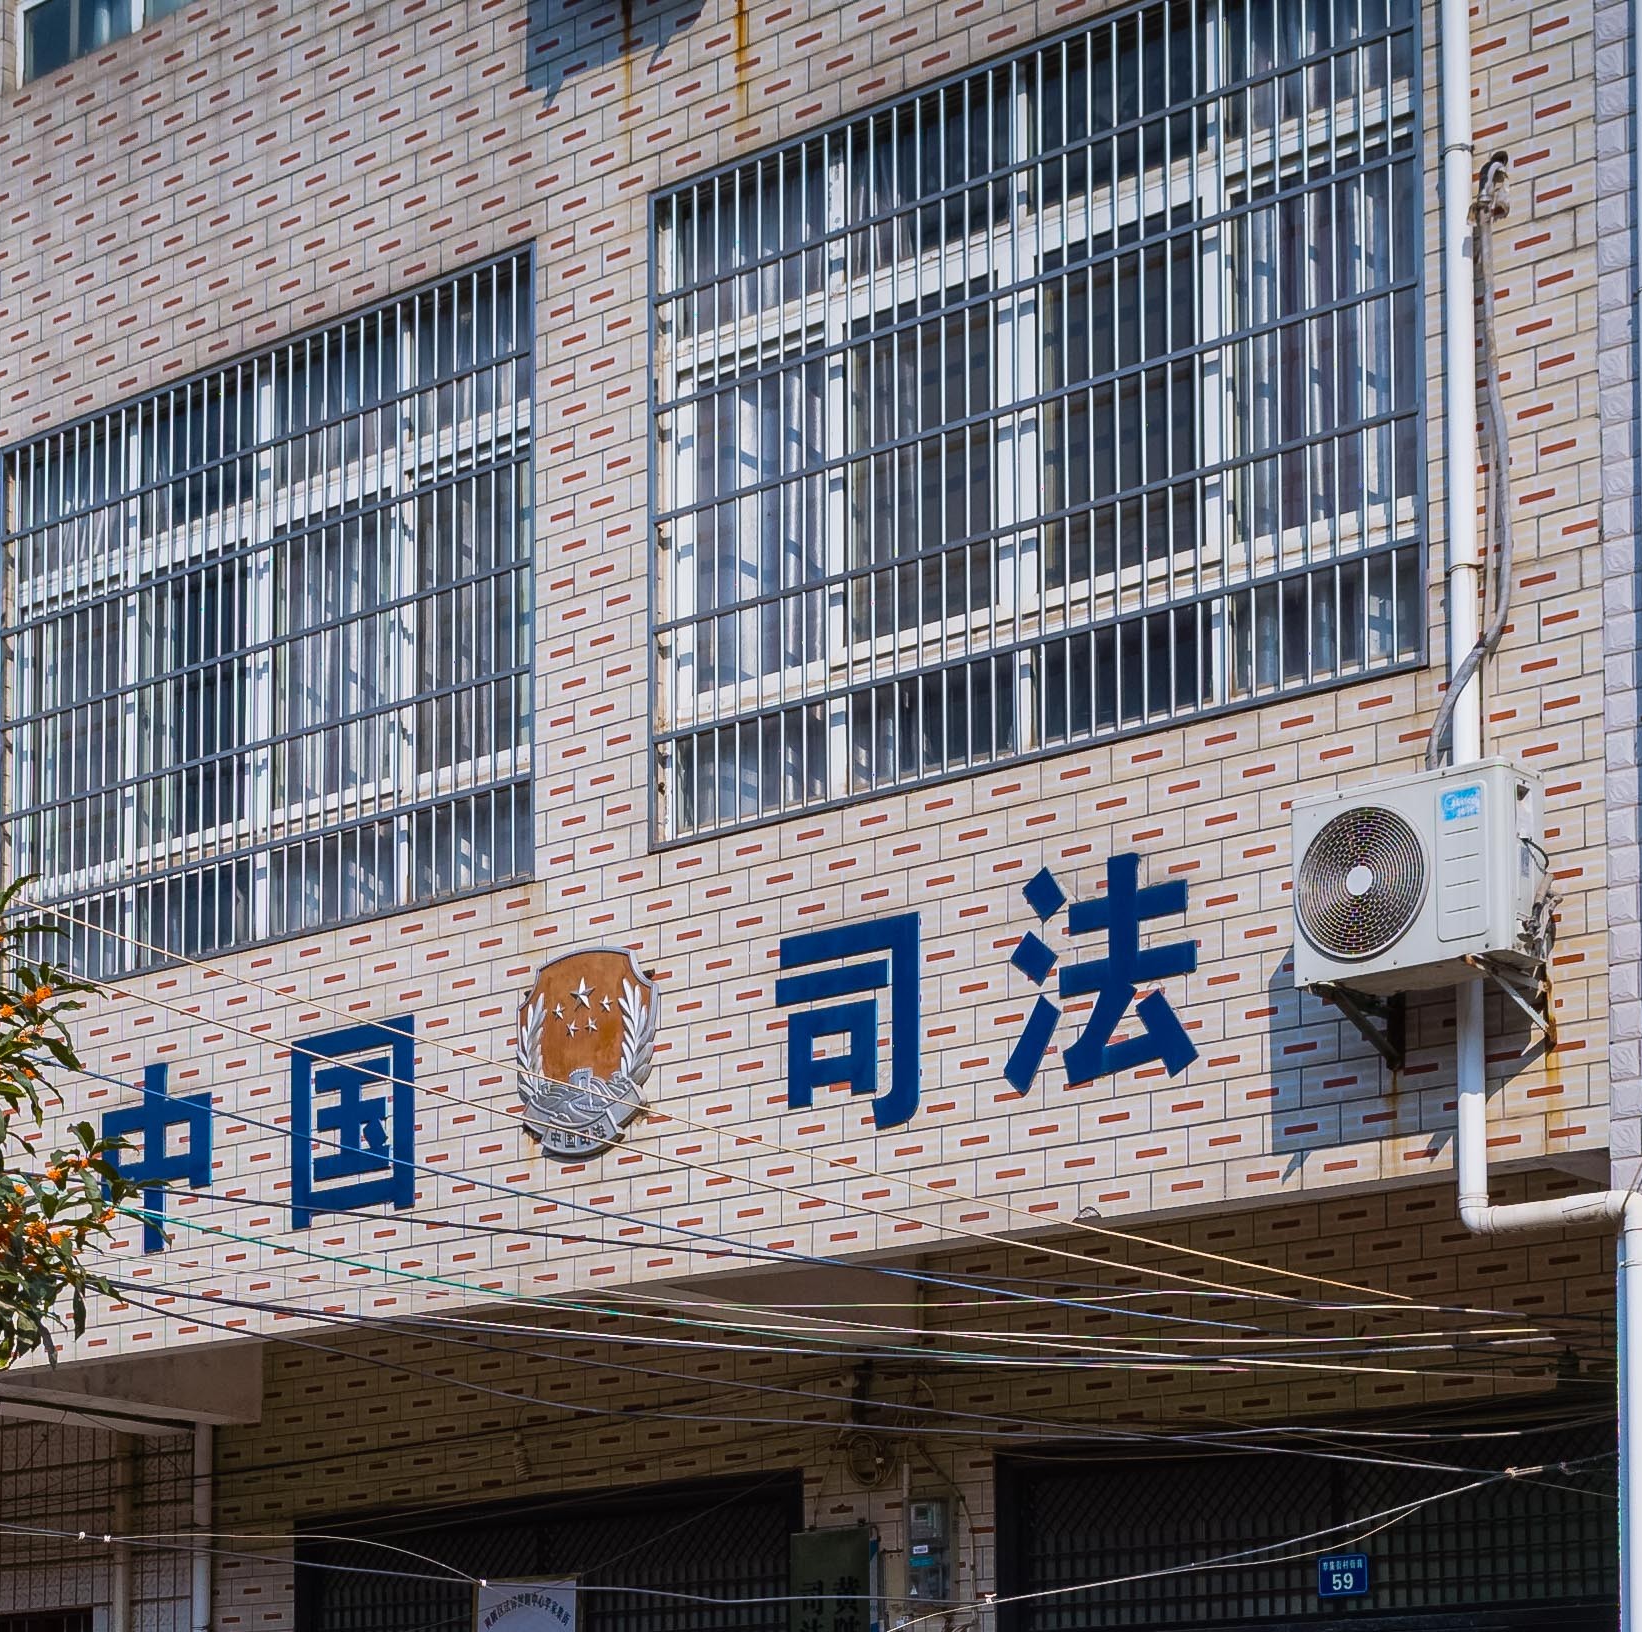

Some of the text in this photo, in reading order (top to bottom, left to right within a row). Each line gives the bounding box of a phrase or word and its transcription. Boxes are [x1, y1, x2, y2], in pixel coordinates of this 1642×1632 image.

[102, 851, 1199, 1255] 中国 司法
[1332, 1572, 1354, 1590] 59
